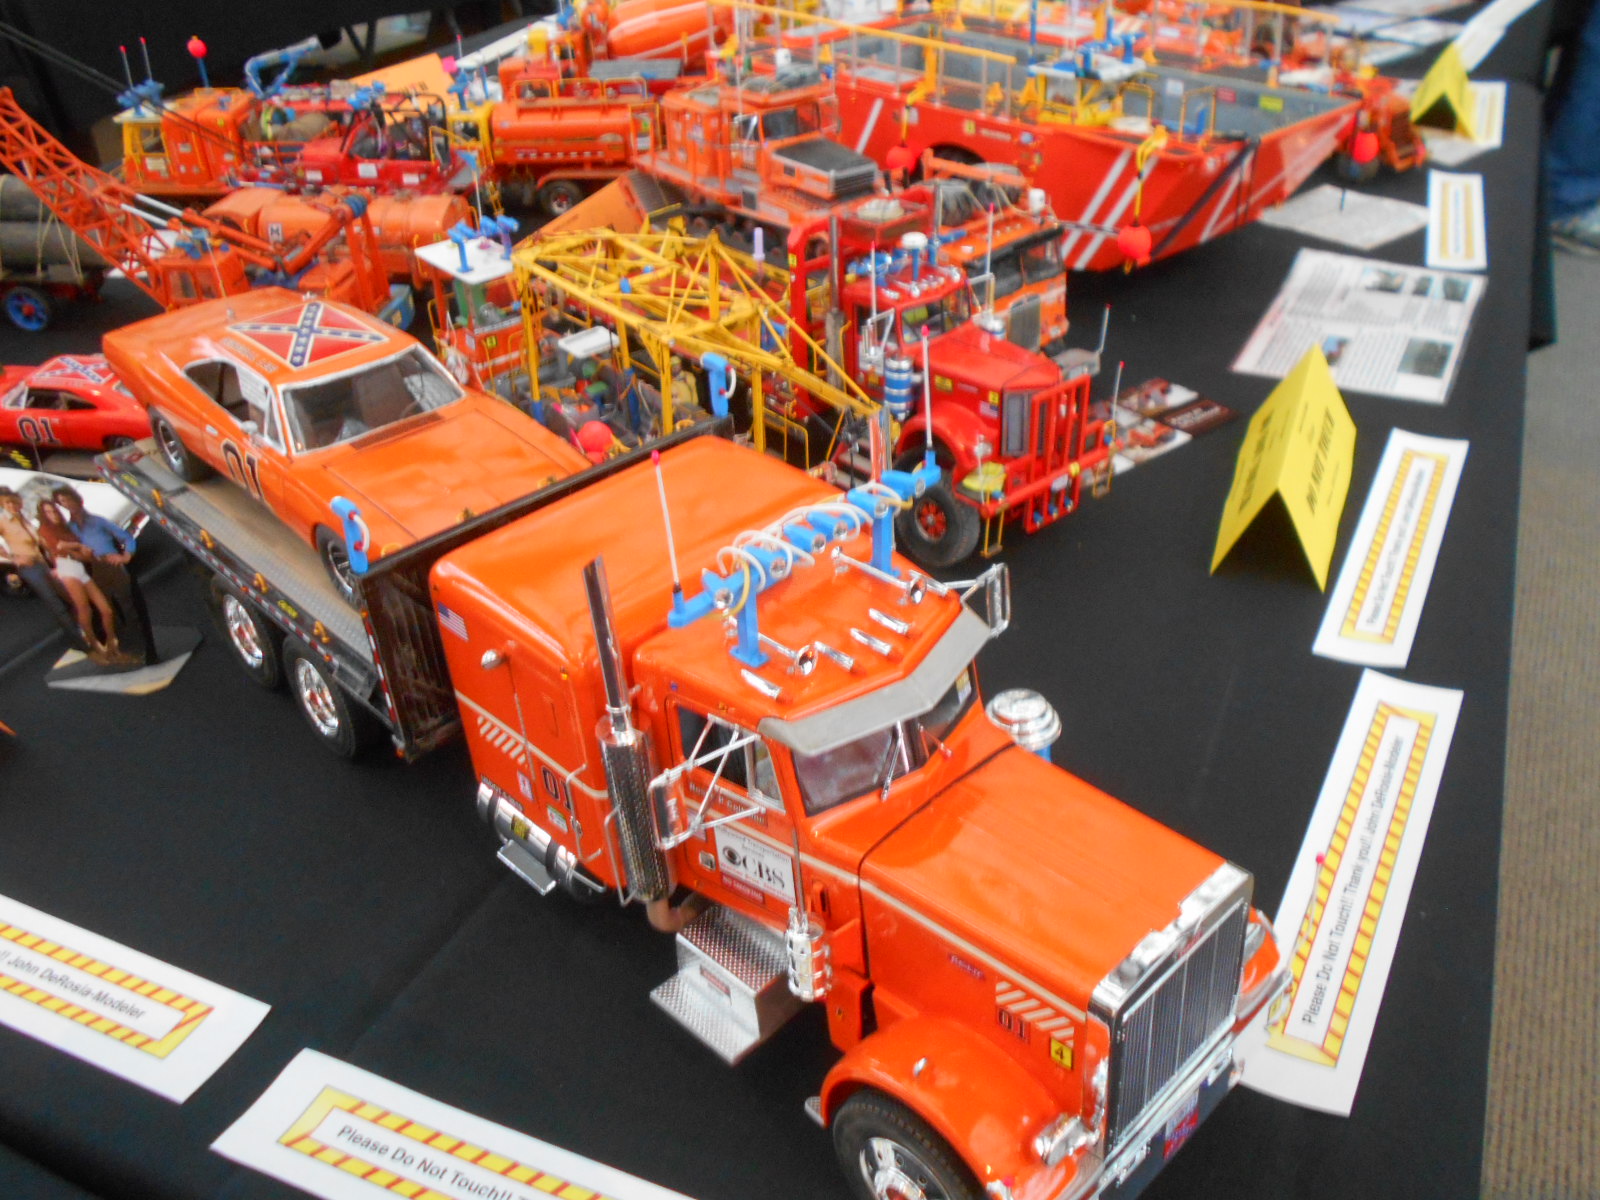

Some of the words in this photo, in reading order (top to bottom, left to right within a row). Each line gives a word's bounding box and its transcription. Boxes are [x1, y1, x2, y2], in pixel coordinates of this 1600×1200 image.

[17, 416, 62, 446] 01
[221, 438, 264, 501] 01
[742, 856, 785, 889] CBS
[1302, 984, 1328, 1024] Please
[1316, 963, 1332, 981] Do
[1327, 938, 1340, 962] Not
[1343, 860, 1364, 895] Thank
[8, 955, 40, 975] John
[40, 968, 147, 1020] DeRosia-Modeler
[1054, 1046, 1064, 1060] 4
[337, 1124, 389, 1156] Please
[391, 1147, 415, 1165] Do
[417, 1161, 448, 1181] Not
